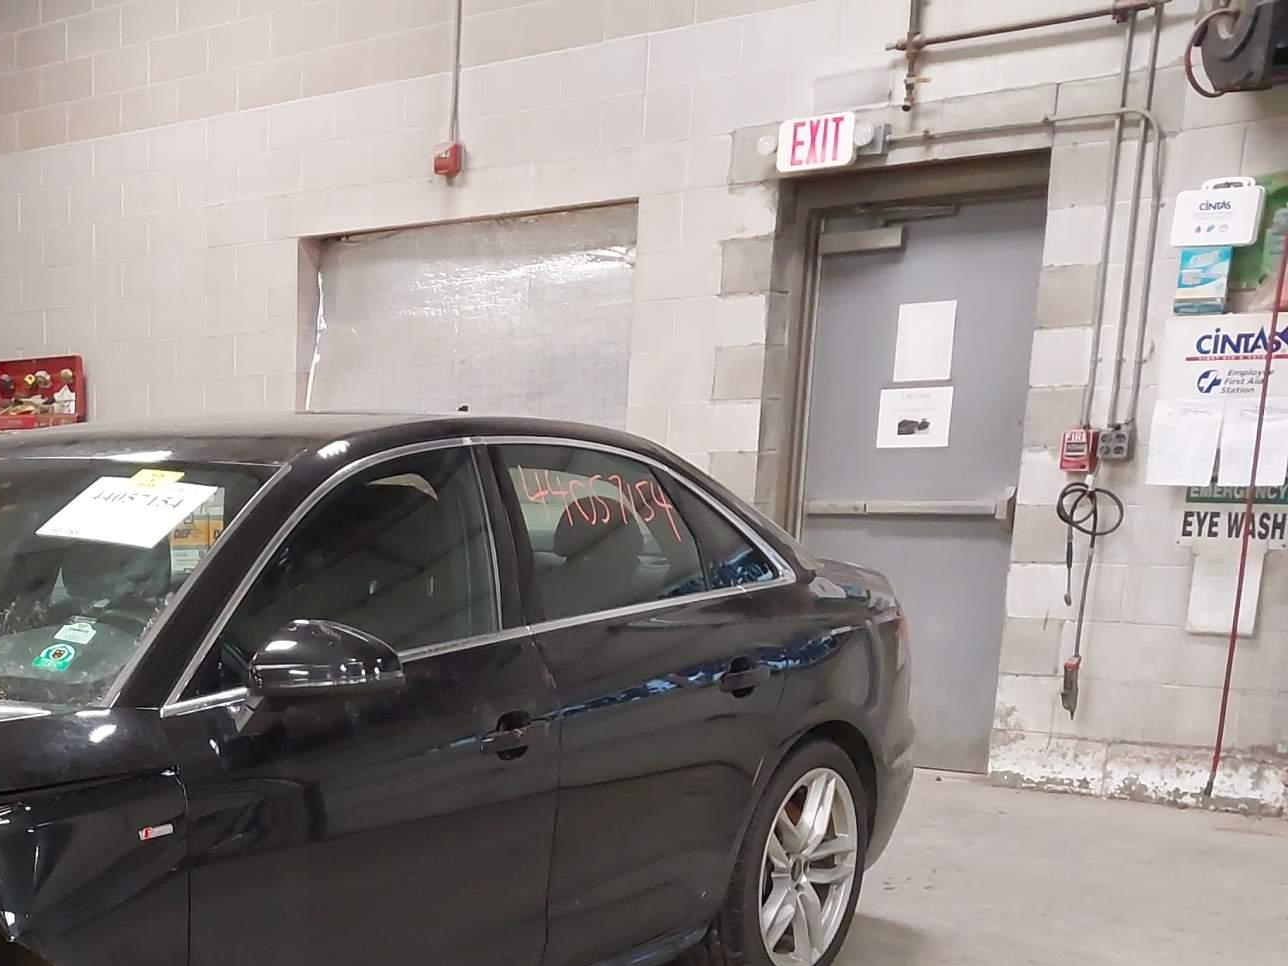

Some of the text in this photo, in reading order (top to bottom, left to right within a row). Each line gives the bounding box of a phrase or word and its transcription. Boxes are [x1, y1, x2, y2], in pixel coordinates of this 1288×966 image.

[790, 116, 844, 166] EXIT
[1227, 368, 1274, 378] Employ
[1220, 386, 1255, 394] Station
[1190, 485, 1288, 499] EMERGNCY
[518, 465, 681, 542] 44057154
[1182, 511, 1287, 540] EYE WASH
